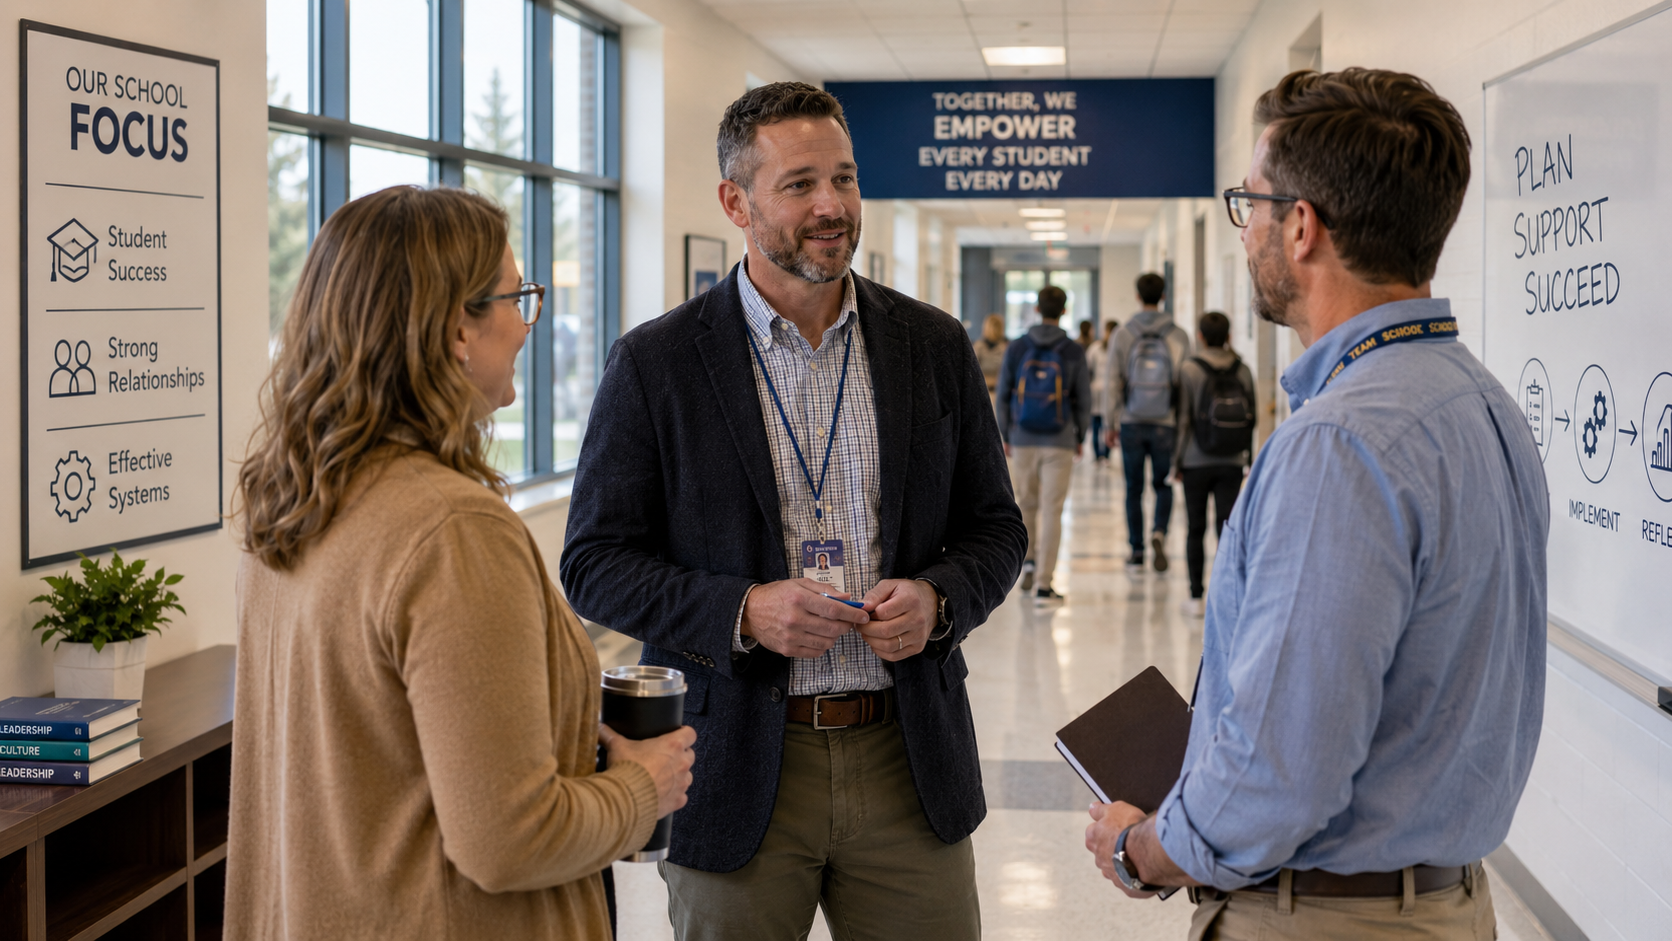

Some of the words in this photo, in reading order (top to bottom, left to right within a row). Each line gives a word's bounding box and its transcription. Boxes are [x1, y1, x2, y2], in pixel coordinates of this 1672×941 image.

[66, 66, 108, 97] OUR
[114, 74, 188, 109] SCHOOL
[932, 91, 1040, 113] TOGETHER,
[1043, 91, 1077, 110] WE
[70, 103, 189, 163] FOCUS
[934, 114, 1077, 140] EMPOWER
[918, 146, 987, 167] EVERY
[992, 146, 1092, 167] STUDENT
[1514, 133, 1573, 197] PLAN
[945, 170, 1013, 191] EVERY
[1018, 170, 1063, 191] DAY
[108, 224, 167, 249] Student
[1513, 196, 1609, 259] SUPPORT
[108, 258, 167, 282] Success
[1524, 262, 1621, 316] SUCCEED
[108, 336, 159, 363] Strong
[1347, 337, 1378, 360] TEAM
[108, 367, 205, 393] Relationships
[108, 448, 173, 475] Effective
[108, 484, 170, 514] Systems
[1568, 498, 1621, 533] IMPLEMENT
[0, 724, 53, 735] LEADERSHIP
